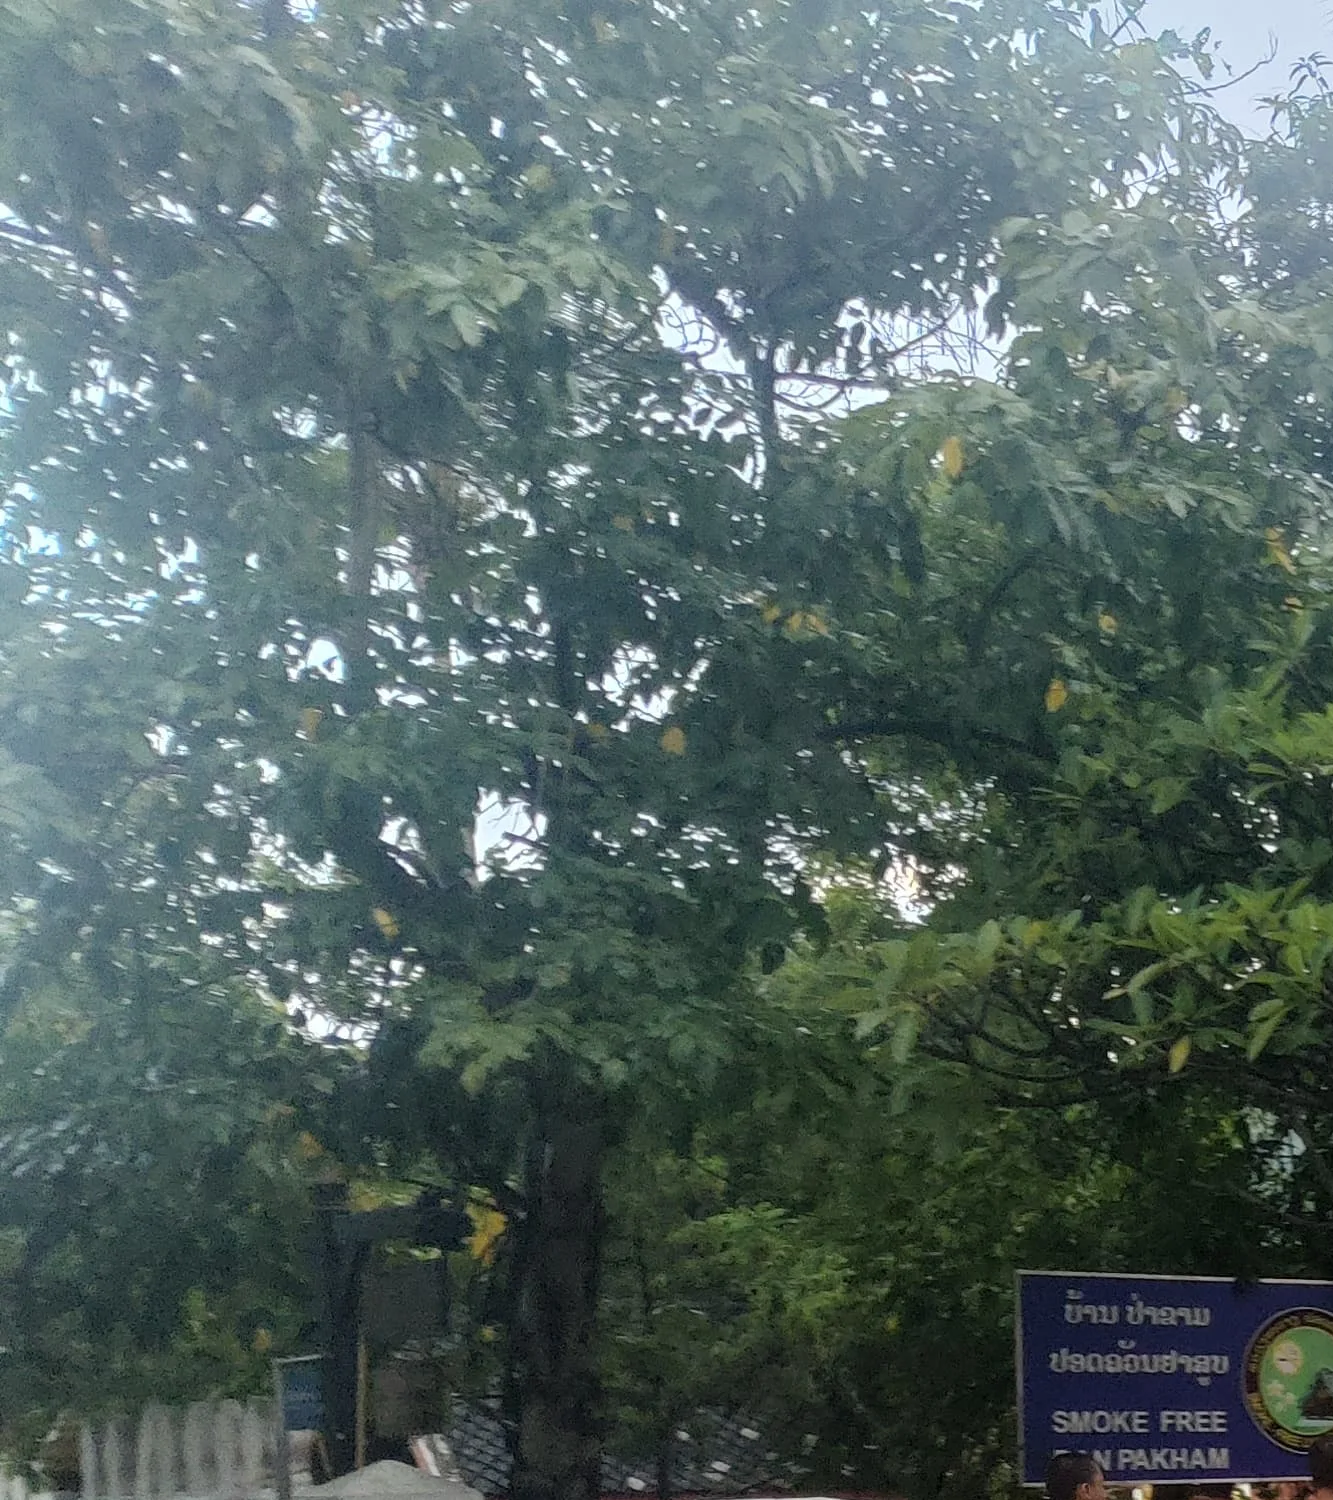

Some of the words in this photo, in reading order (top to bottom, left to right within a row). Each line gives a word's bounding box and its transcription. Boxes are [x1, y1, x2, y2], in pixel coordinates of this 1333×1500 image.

[1064, 1289, 1119, 1324] ບ້ານ
[1052, 1411, 1149, 1433] SMOKE
[1159, 1411, 1228, 1432] FREE
[1117, 1449, 1230, 1470] PAKHAM
